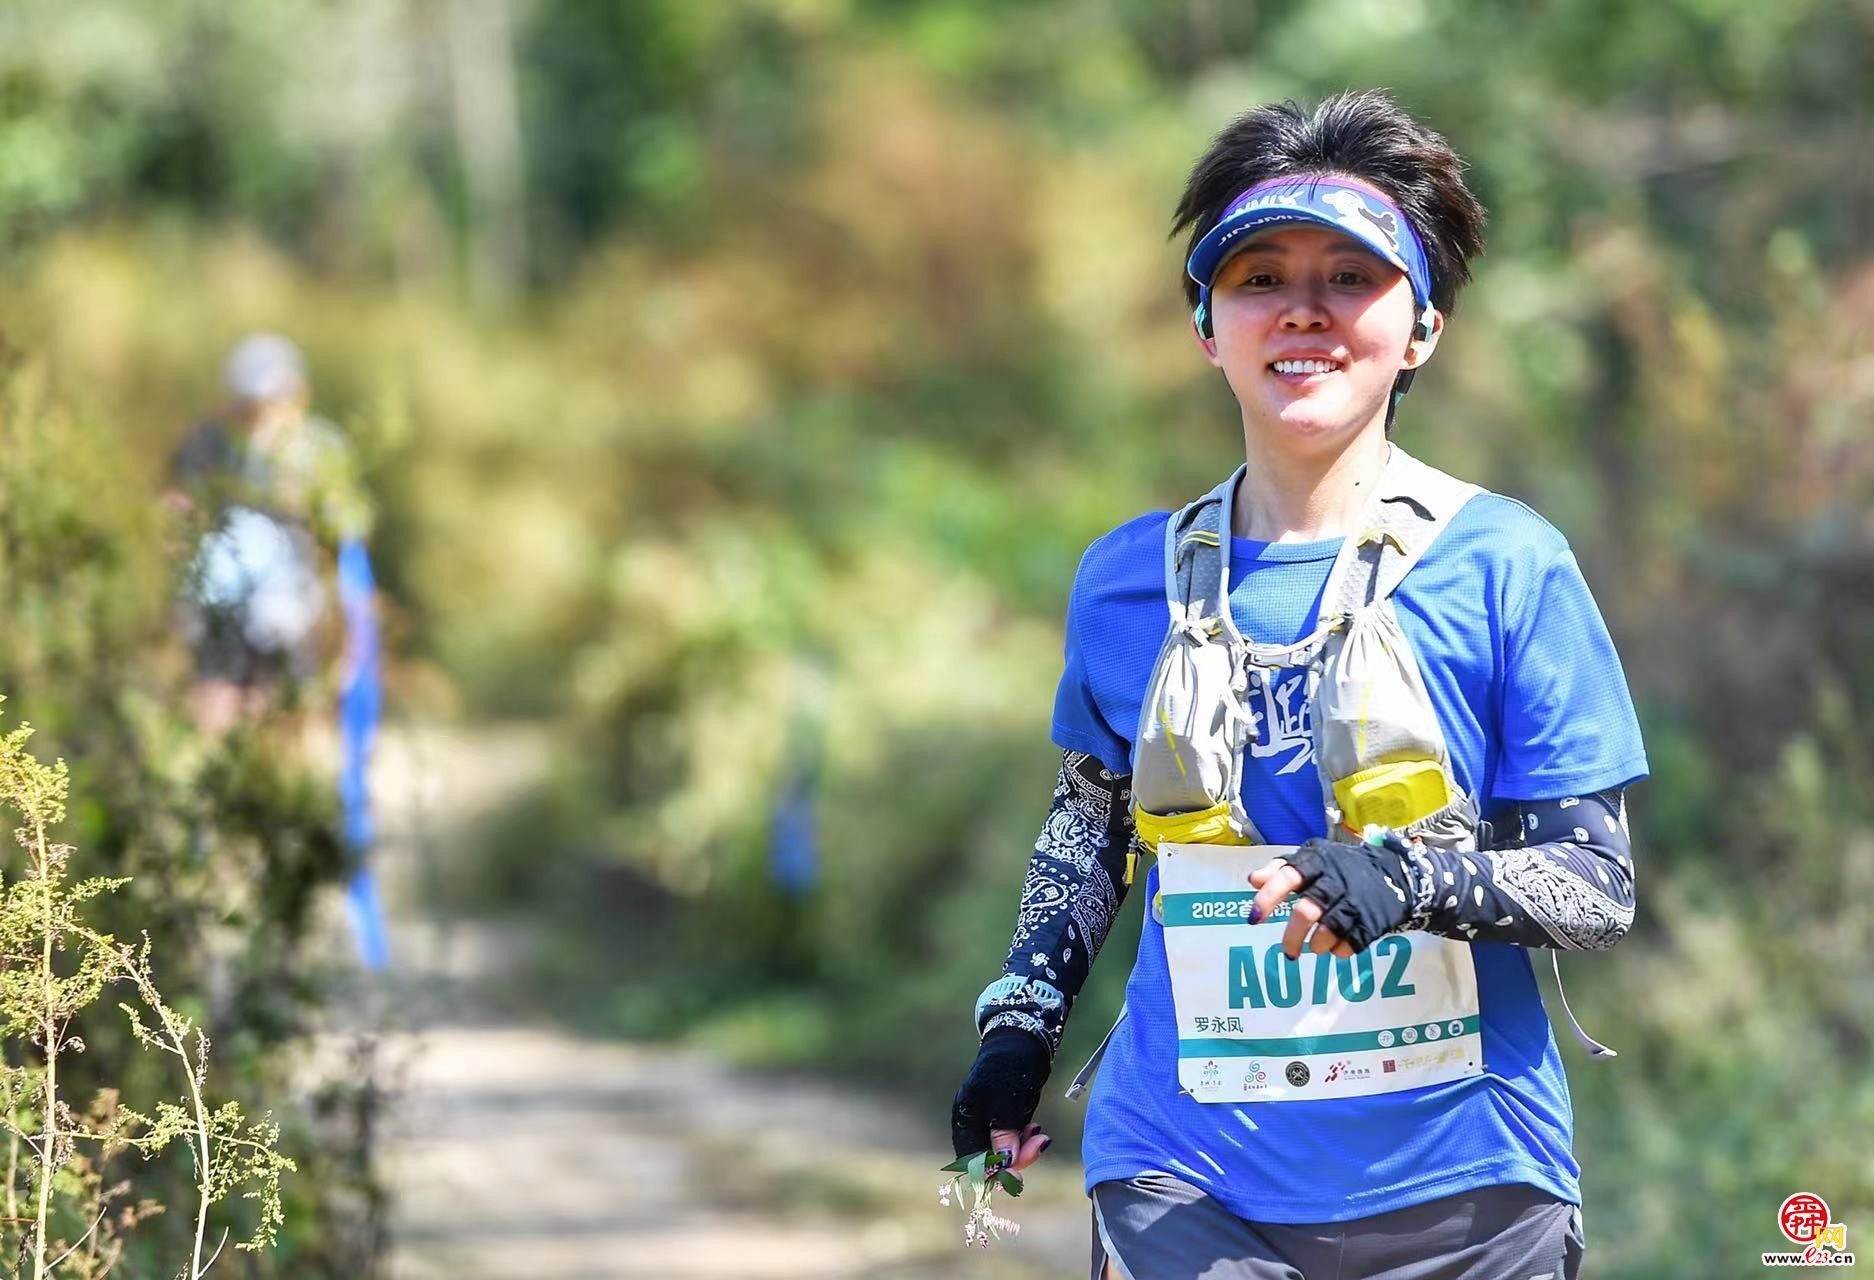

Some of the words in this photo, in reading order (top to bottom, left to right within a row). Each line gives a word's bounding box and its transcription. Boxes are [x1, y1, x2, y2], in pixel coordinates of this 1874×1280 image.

[1228, 935, 1416, 1010] A0702
[1194, 1016, 1244, 1033] 罗永凤
